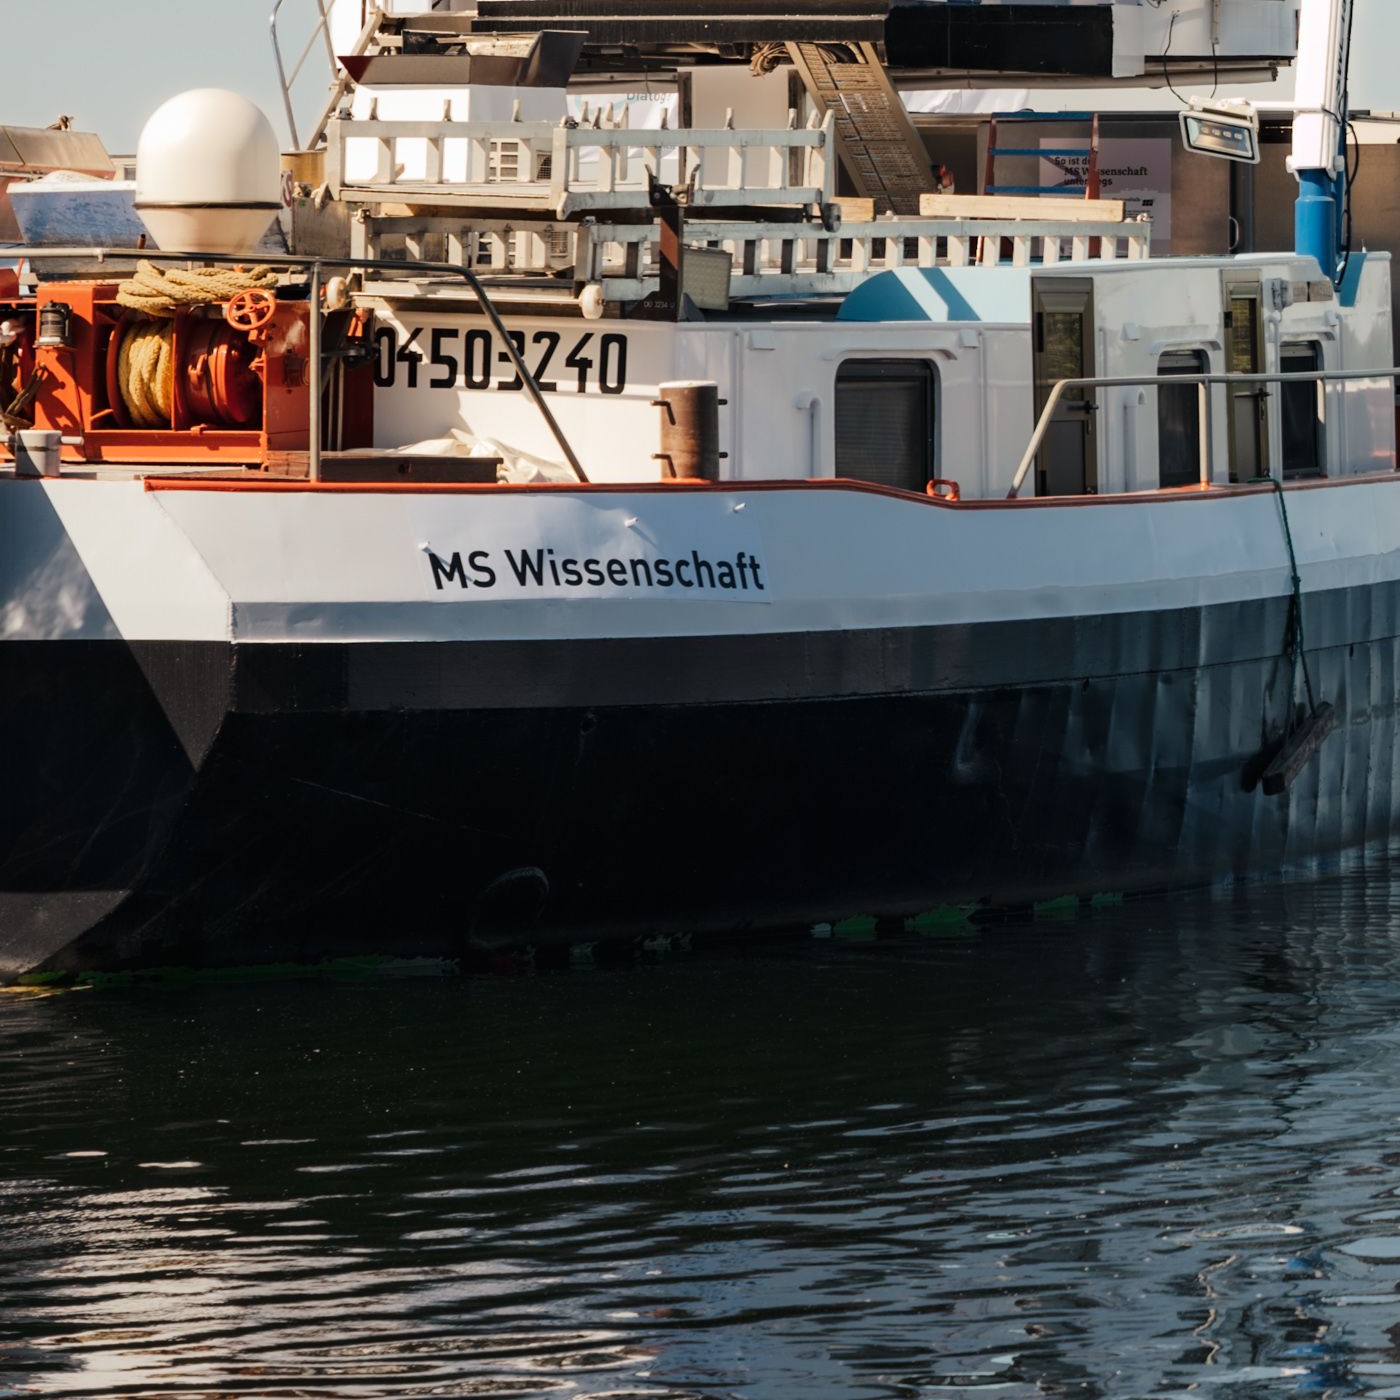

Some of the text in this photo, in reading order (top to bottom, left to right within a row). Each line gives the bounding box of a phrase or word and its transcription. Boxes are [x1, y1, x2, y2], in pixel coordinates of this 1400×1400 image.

[1064, 166, 1148, 176] MS Wsenschaft
[1068, 156, 1080, 166] ist
[373, 327, 628, 394] 04503240
[428, 548, 765, 590] MS Wissenschaft
